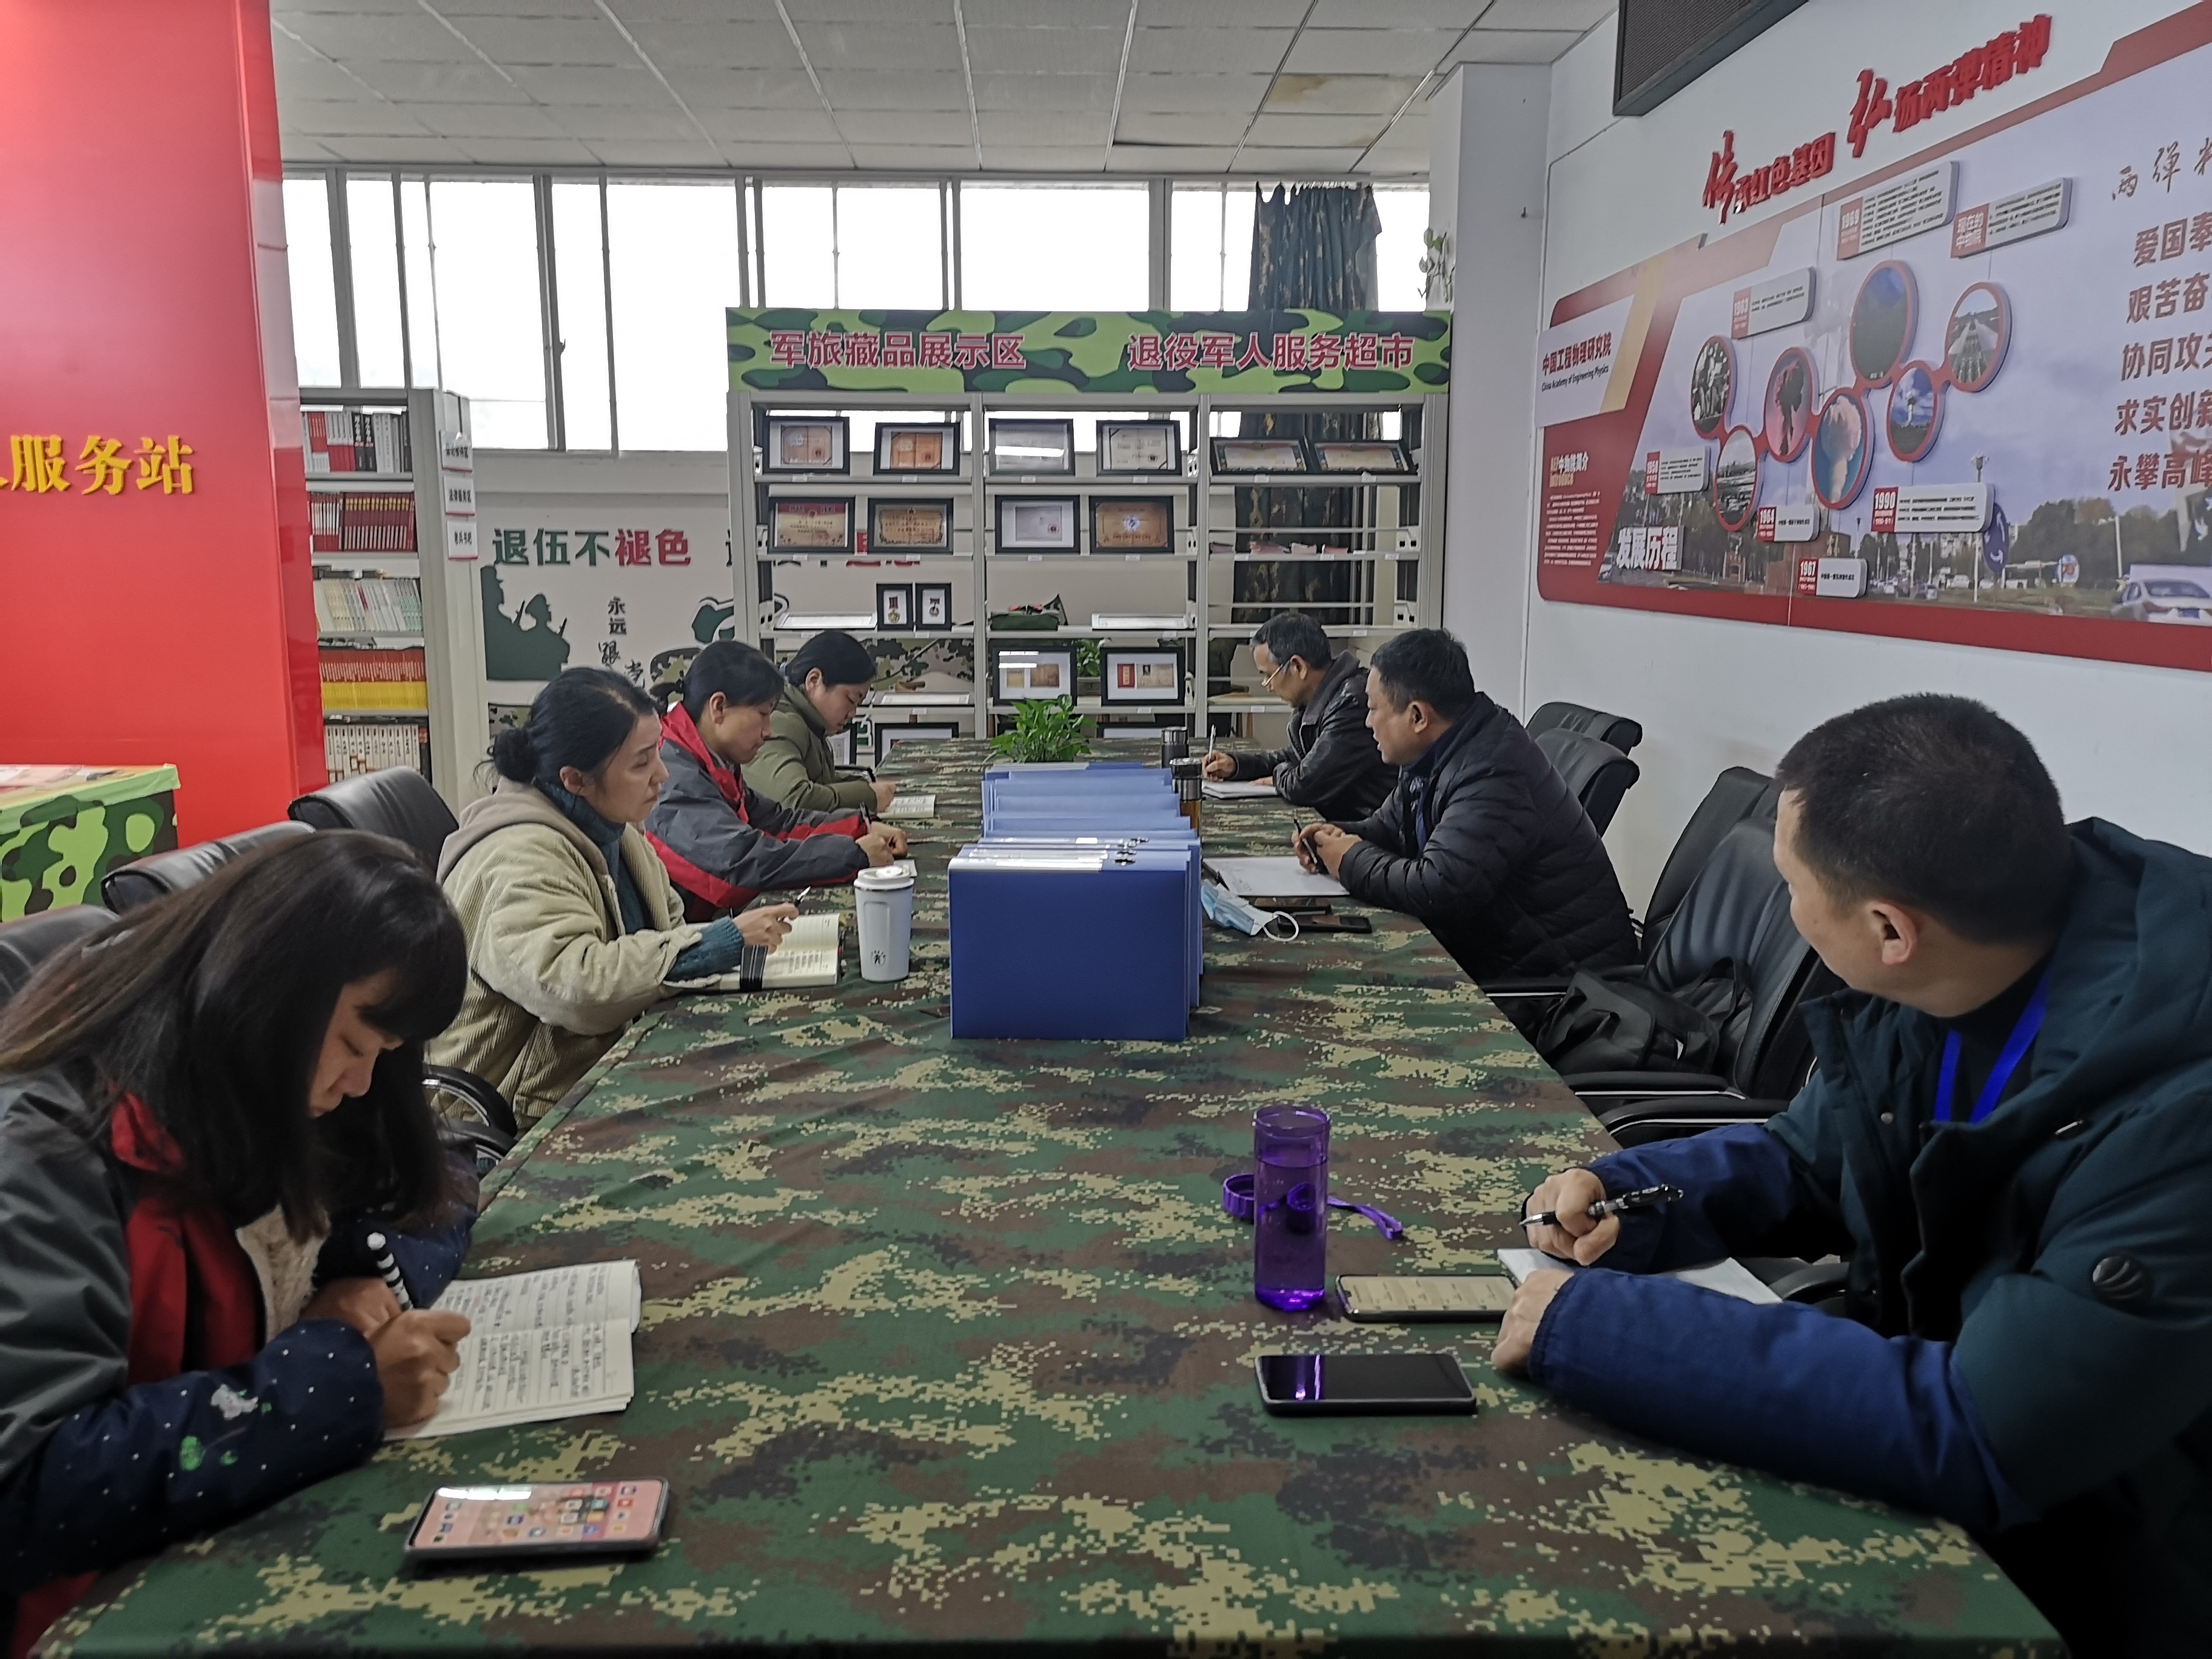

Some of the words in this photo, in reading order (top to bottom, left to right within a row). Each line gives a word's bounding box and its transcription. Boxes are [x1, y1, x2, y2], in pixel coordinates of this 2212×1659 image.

[1847, 13, 2052, 158] 弘扬两弹精神
[1703, 130, 1835, 225] 传承红色基因
[2127, 272, 2212, 324] 艰苦奋
[770, 330, 1026, 369] 军旅藏品展示区
[1128, 332, 1415, 371] 退役军人服务超市
[1543, 331, 1612, 377] 中国工程物理研究院
[0, 434, 193, 496] 服务站
[2108, 448, 2212, 492] 永攀高峰
[1875, 491, 1896, 510] 1990
[492, 528, 691, 566] 退伍不褪色
[1616, 526, 1678, 570] 发展历程
